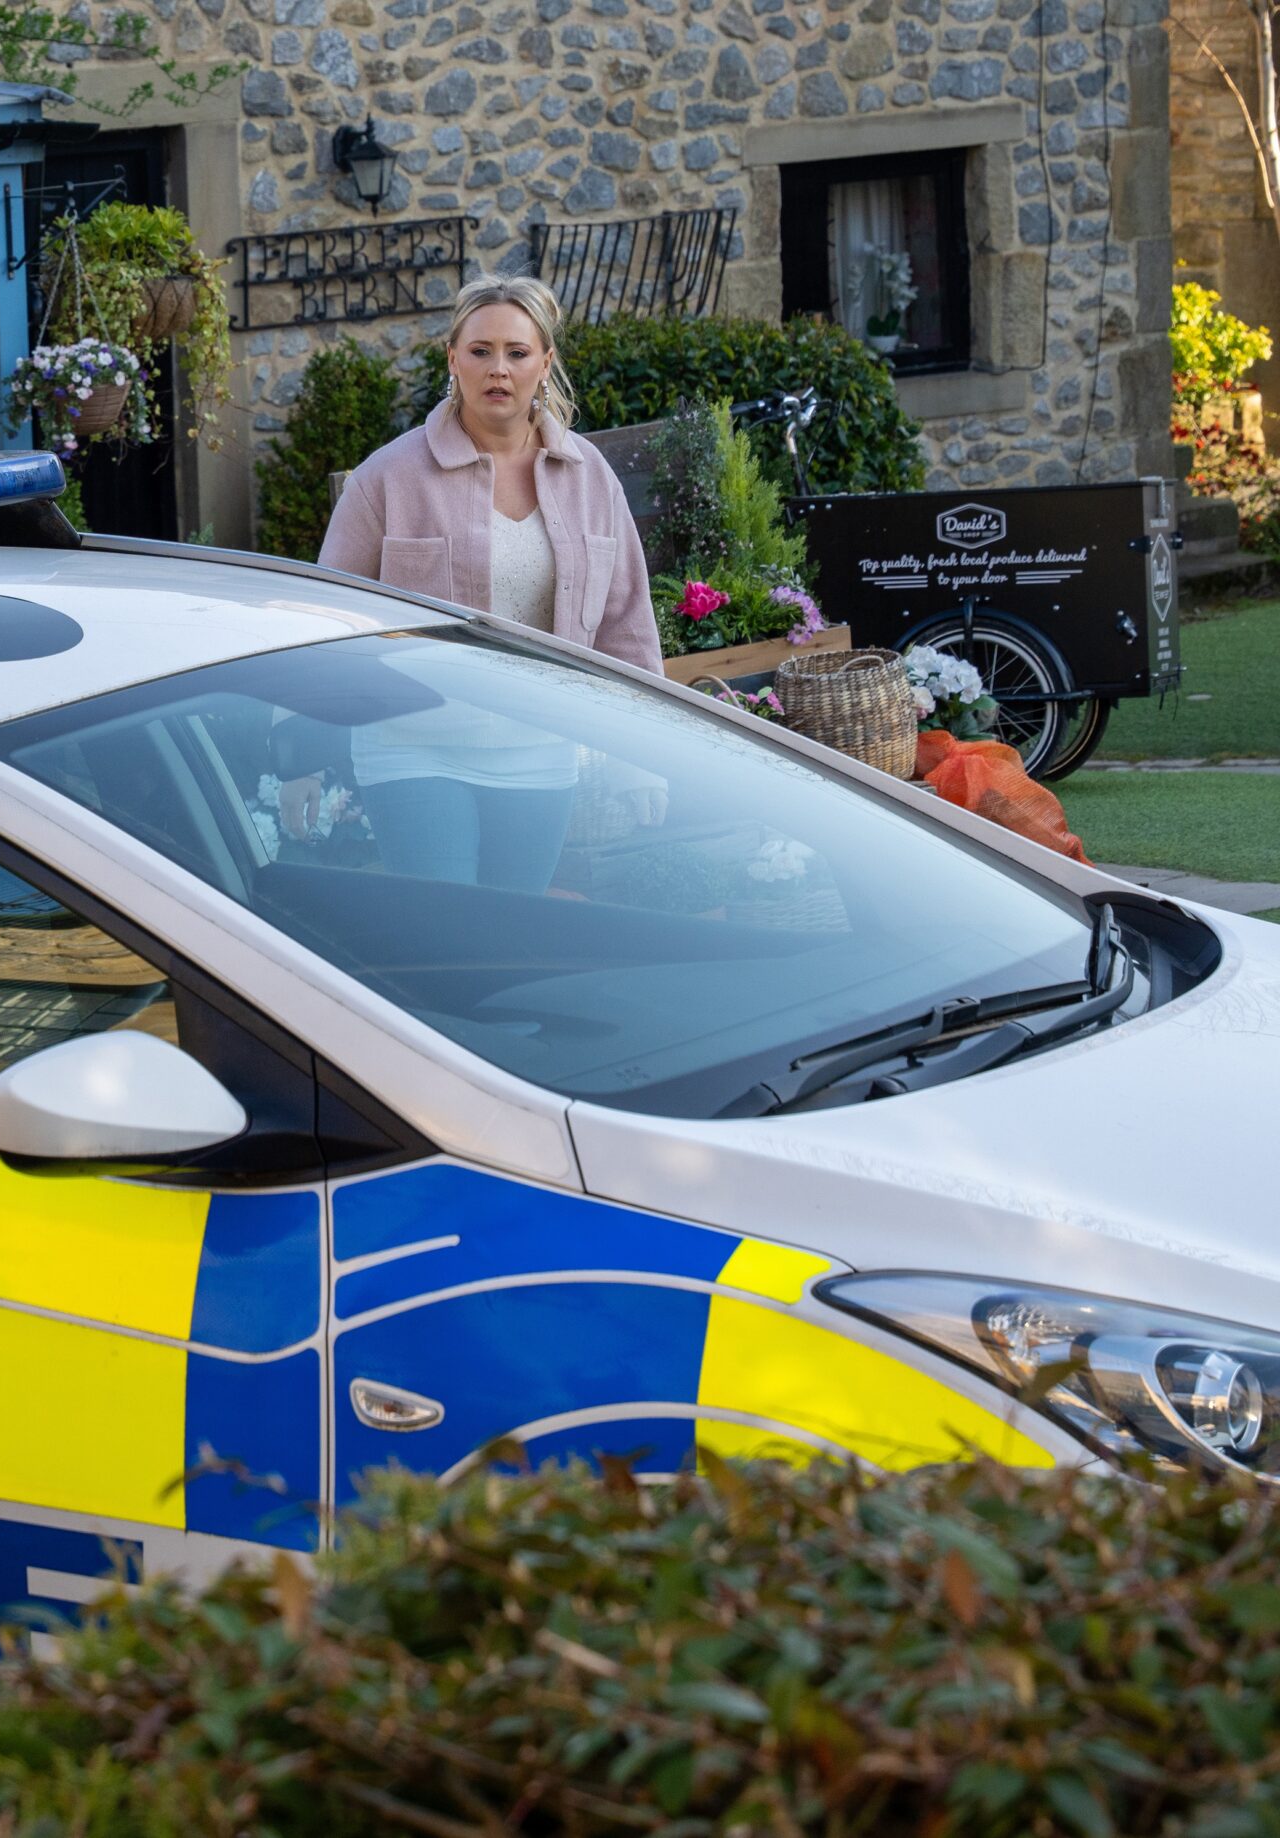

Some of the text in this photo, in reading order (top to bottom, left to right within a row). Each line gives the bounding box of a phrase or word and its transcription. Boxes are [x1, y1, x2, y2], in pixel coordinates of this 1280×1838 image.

[294, 270, 424, 321] BARN
[944, 514, 1000, 532] David's
[858, 547, 1087, 573] Top quality, fresh local produce delivered
[937, 570, 1008, 590] to your door
